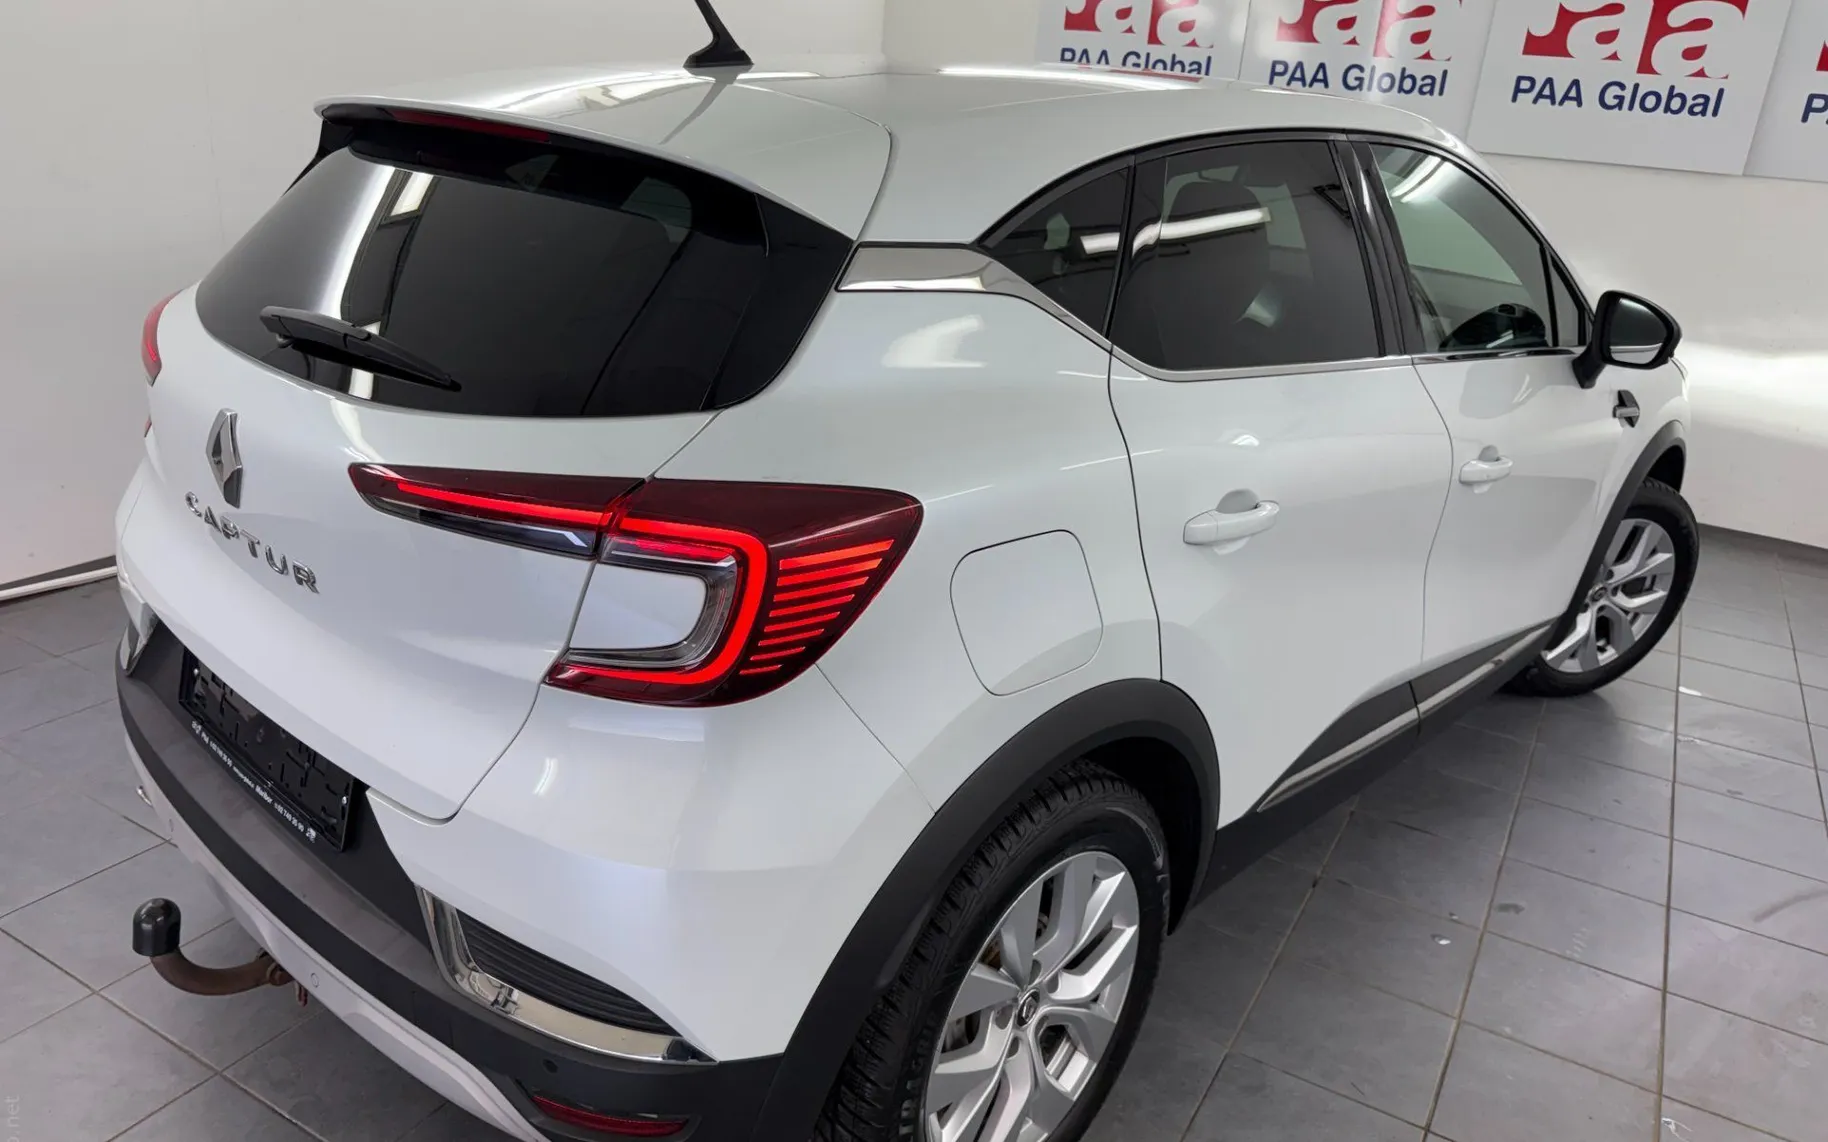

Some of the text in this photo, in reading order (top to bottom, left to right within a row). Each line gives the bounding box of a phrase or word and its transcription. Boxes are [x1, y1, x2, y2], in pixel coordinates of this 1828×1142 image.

[1268, 60, 1449, 97] PAA Global
[1510, 75, 1725, 118] PAA Global
[1801, 93, 1828, 125] P
[184, 491, 320, 594] CAPTUR
